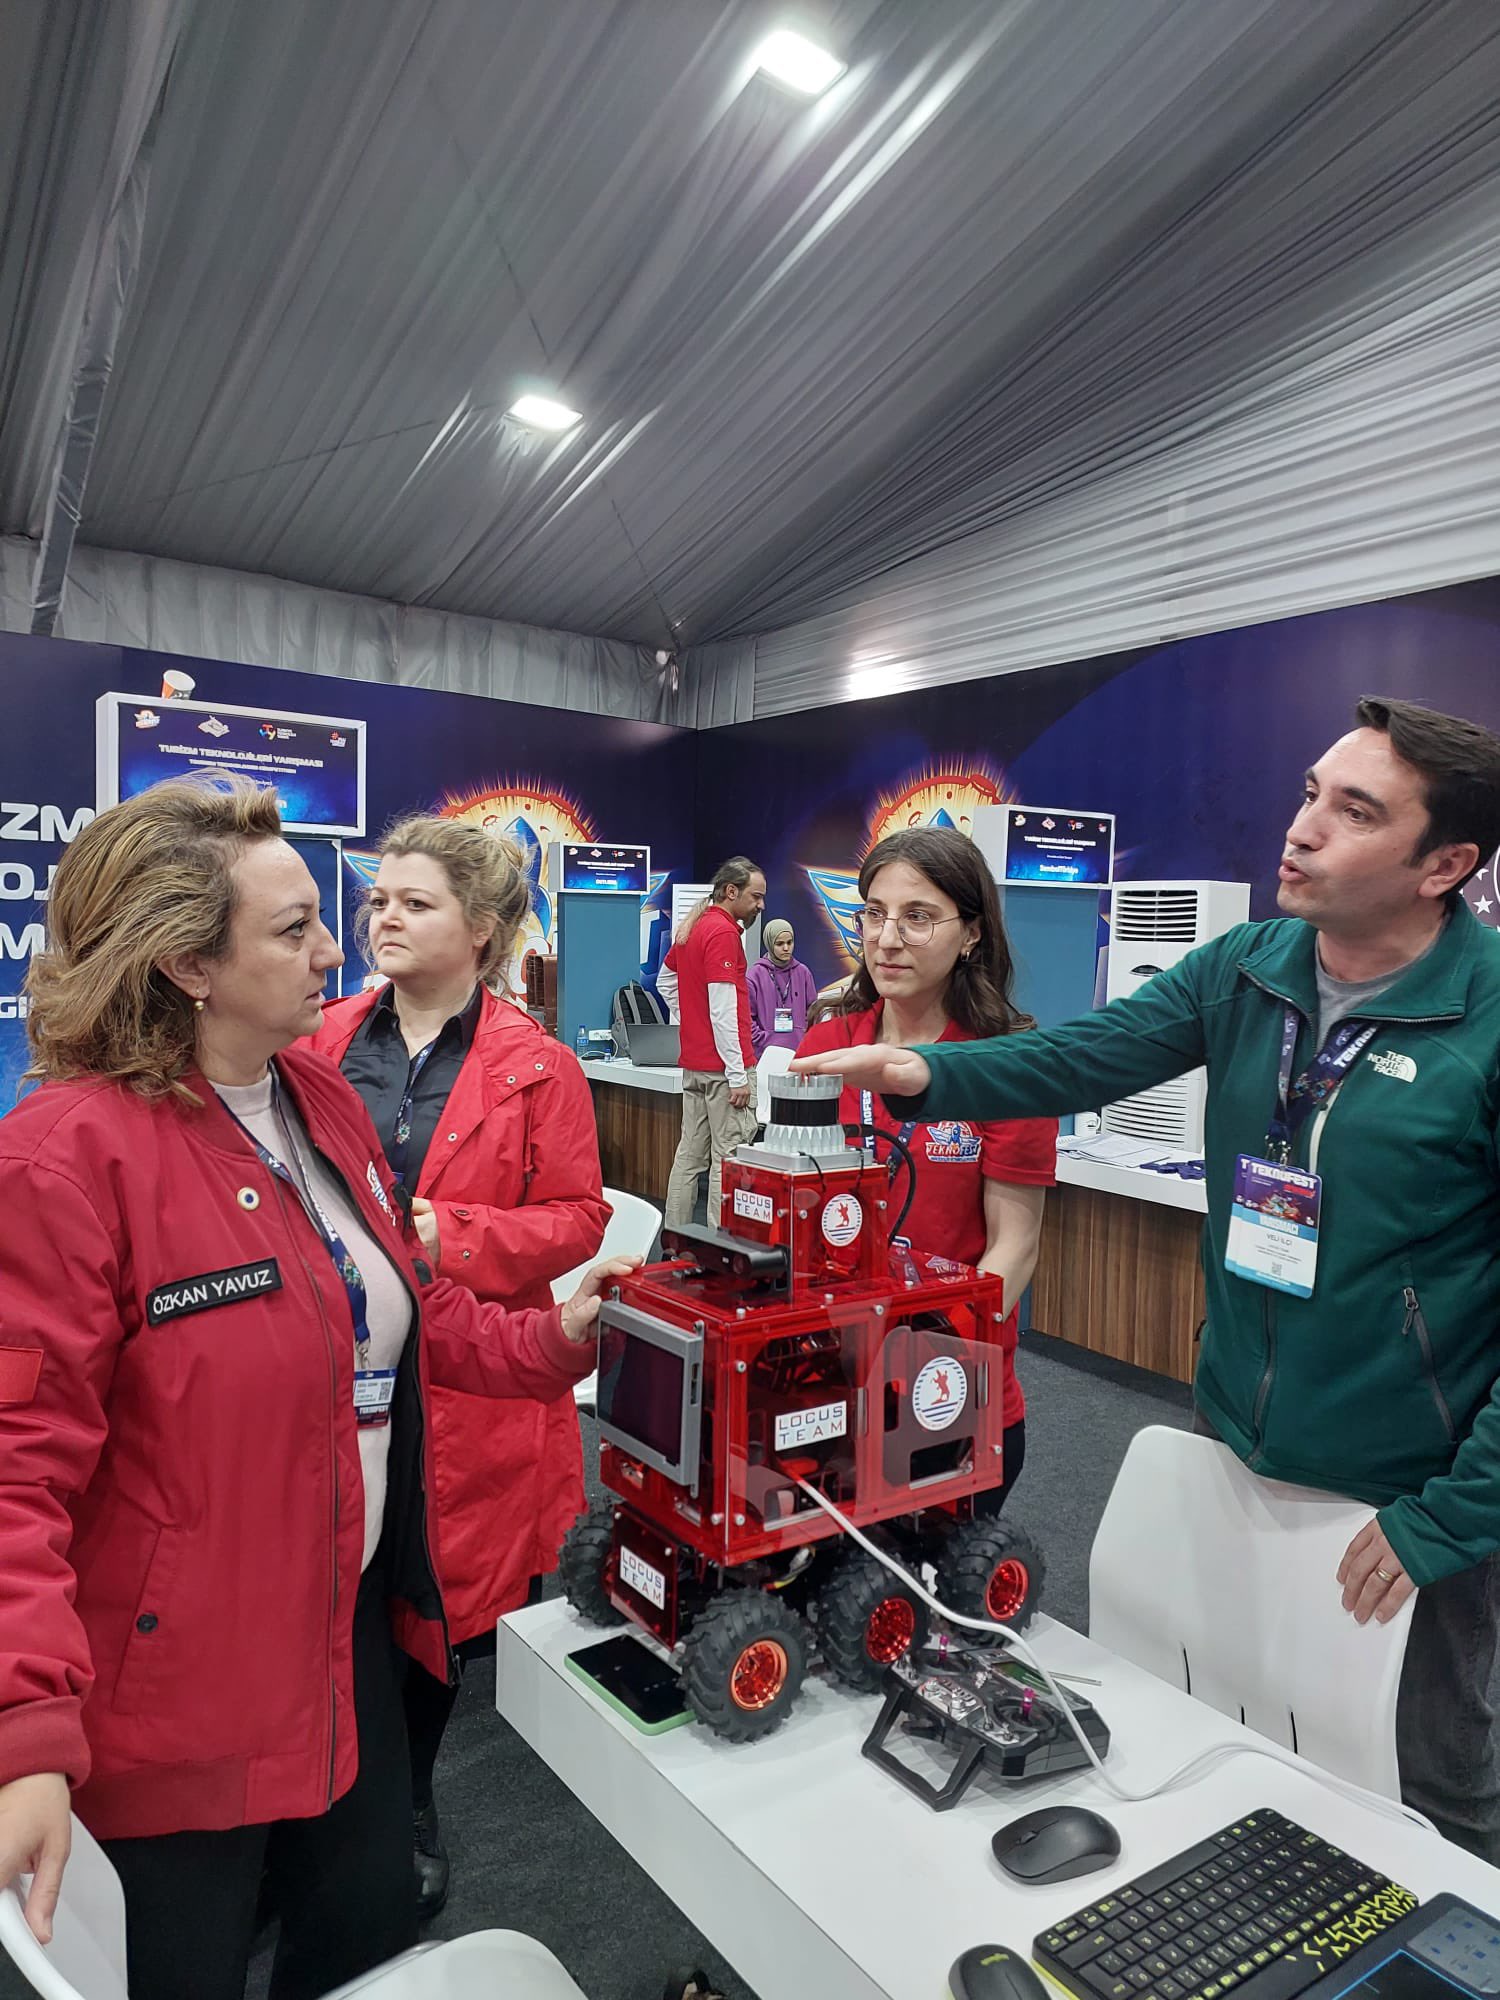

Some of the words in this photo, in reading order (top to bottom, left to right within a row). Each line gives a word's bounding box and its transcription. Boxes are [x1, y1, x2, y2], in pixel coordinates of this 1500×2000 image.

[1367, 1053, 1402, 1071] NORTH
[1386, 1050, 1407, 1062] THE
[1373, 1065, 1402, 1077] FACE
[926, 1141, 981, 1157] TEKNOFEST
[1251, 1162, 1318, 1189] TEKNOFEST
[735, 1190, 771, 1209] LOCUS
[736, 1202, 771, 1220] TEAM
[153, 1284, 208, 1315] ÖZKAN
[211, 1268, 273, 1297] YAVUZ
[779, 1405, 843, 1431] LOCUS
[779, 1420, 843, 1445] TEAM
[622, 1551, 662, 1589] LOCUS
[622, 1564, 662, 1605] TEAM
